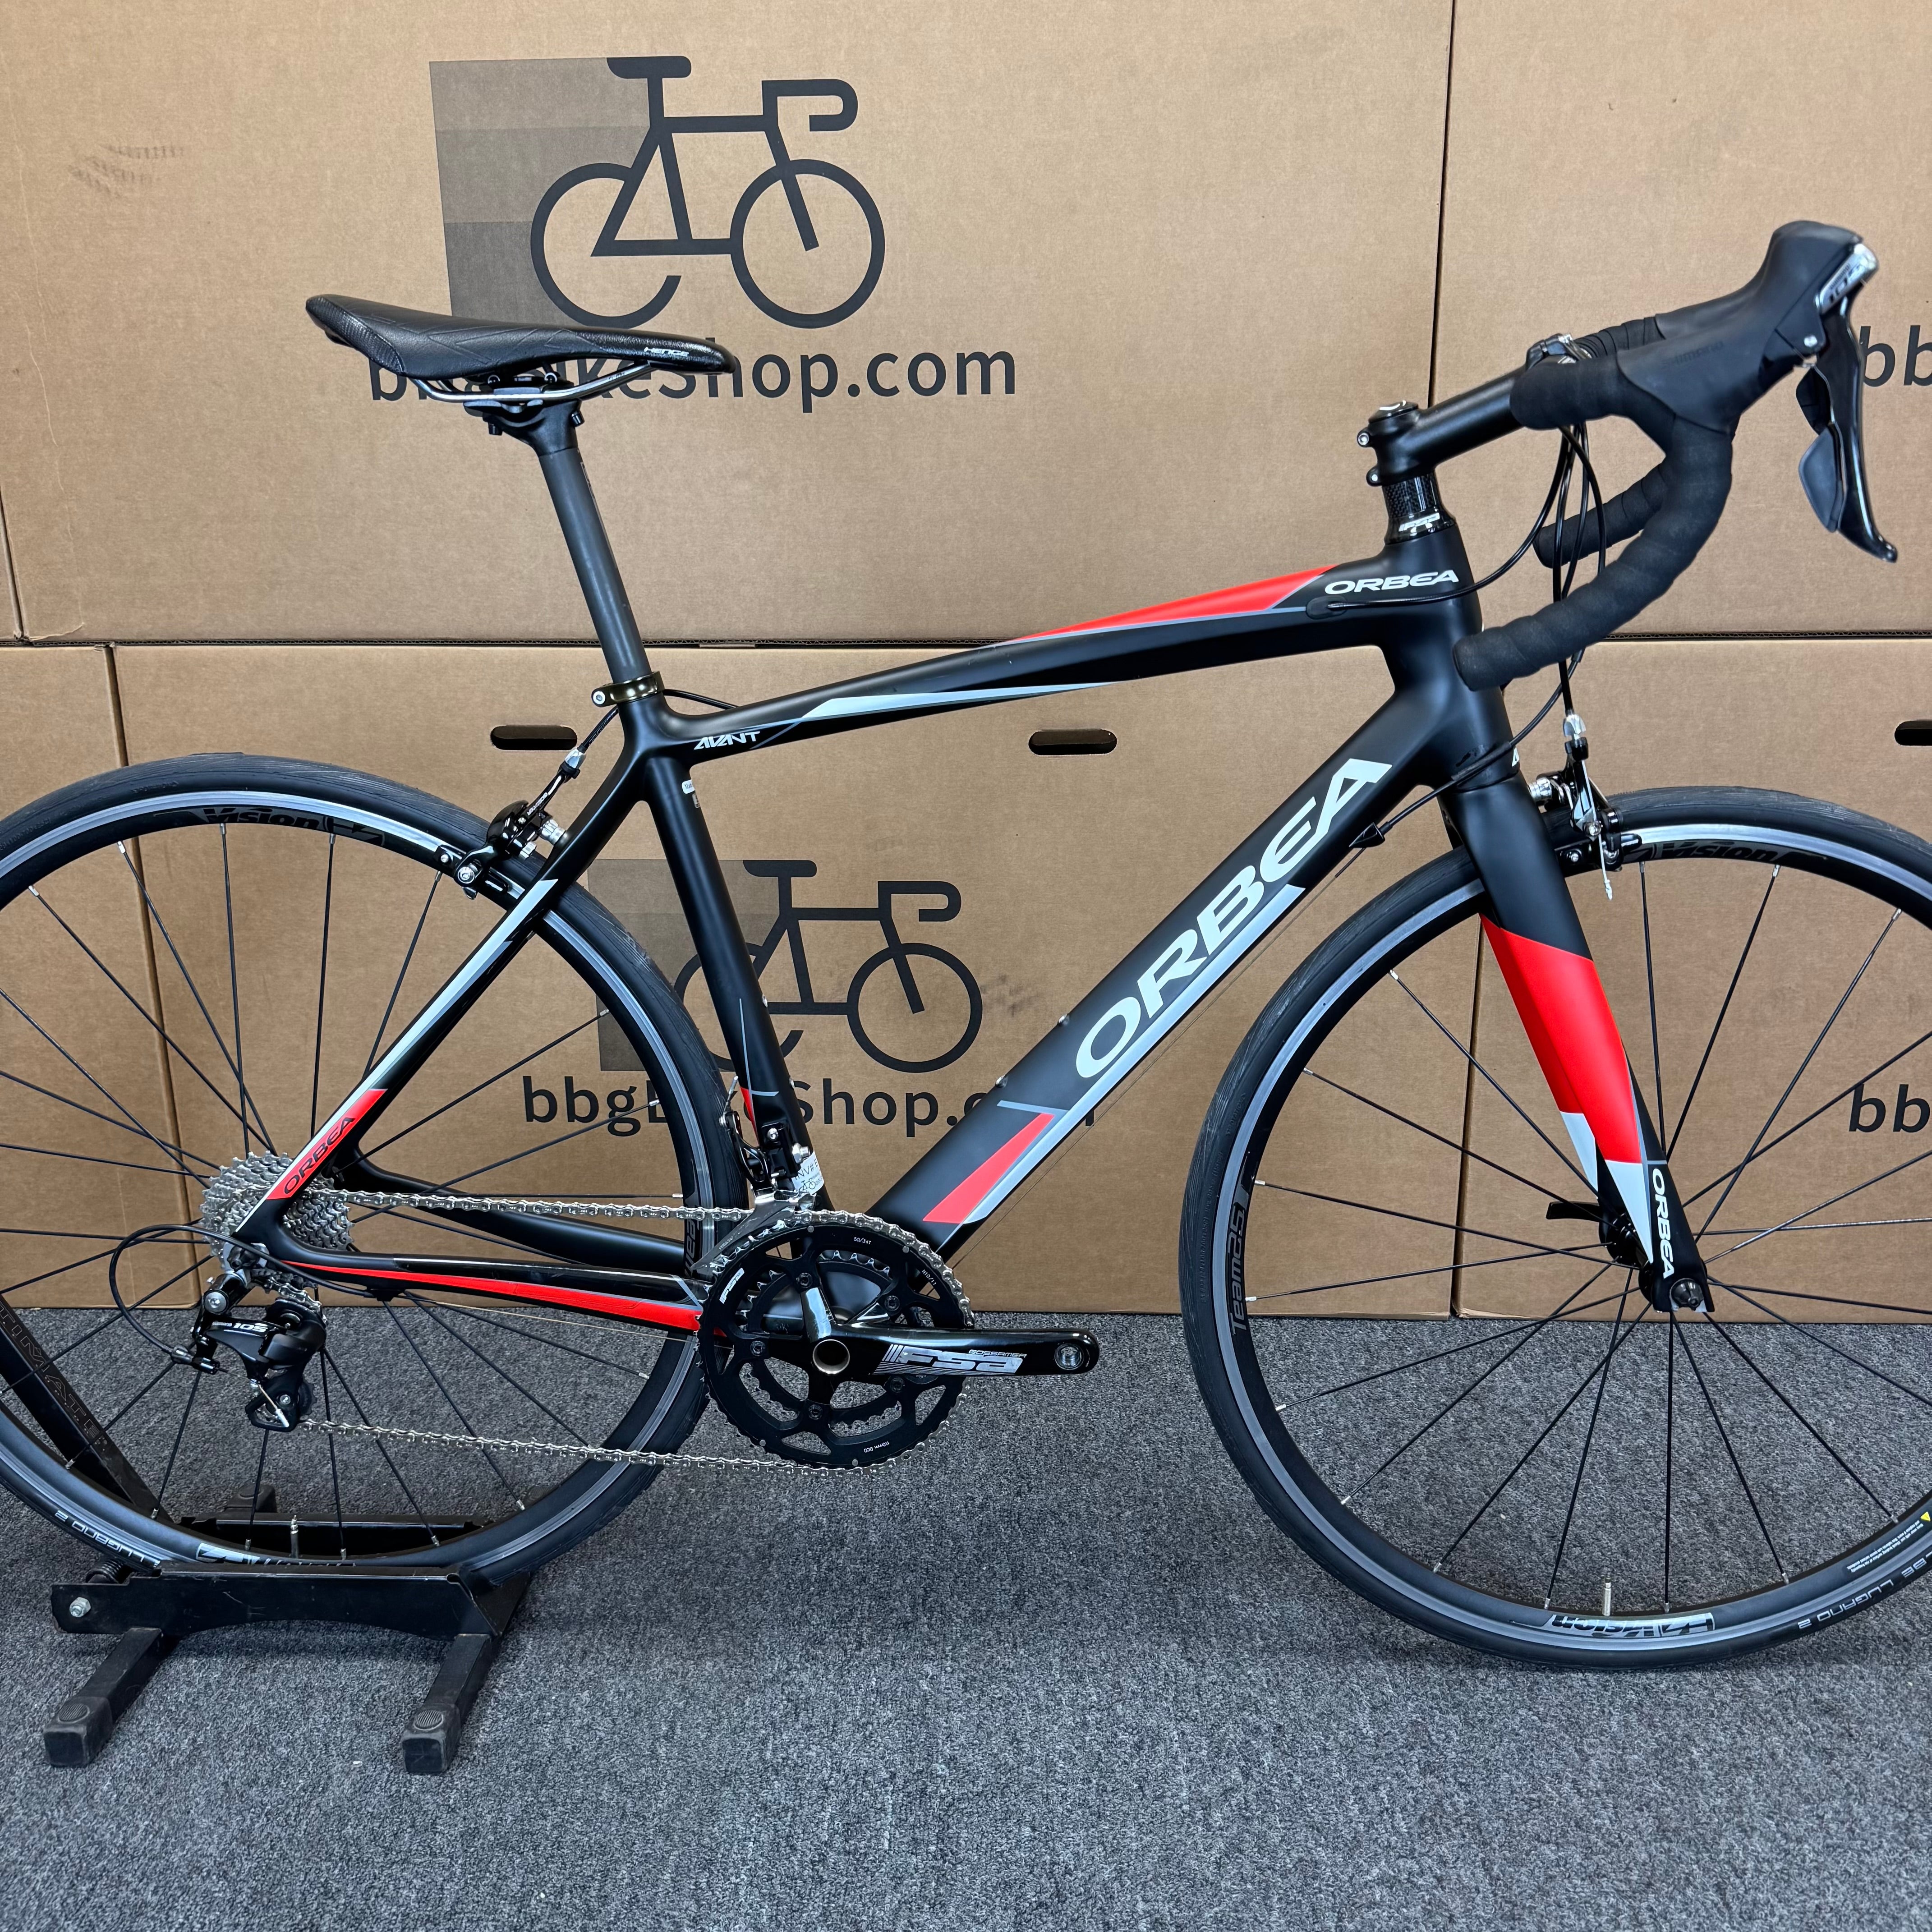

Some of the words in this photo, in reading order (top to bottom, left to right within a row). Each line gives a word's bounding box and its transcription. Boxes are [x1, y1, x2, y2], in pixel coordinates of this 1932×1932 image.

[1325, 570, 1459, 595] ORBEA
[694, 731, 760, 750] AVANT
[203, 807, 320, 829] Vision
[1662, 841, 1778, 862] Vision
[1075, 758, 1393, 1078] ORBEA
[284, 1117, 355, 1194] ORBEA
[1652, 1168, 1674, 1279] ORBEA
[853, 1237, 872, 1245] 50/34T
[921, 1269, 937, 1286] N10/11
[233, 1323, 268, 1332] 105
[968, 1349, 1027, 1359] GOSSAMER
[55, 1510, 68, 1522] 2
[71, 1519, 145, 1563] LUGANO
[1817, 1580, 1894, 1623] LUGANO
[1797, 1619, 1812, 1630] 2
